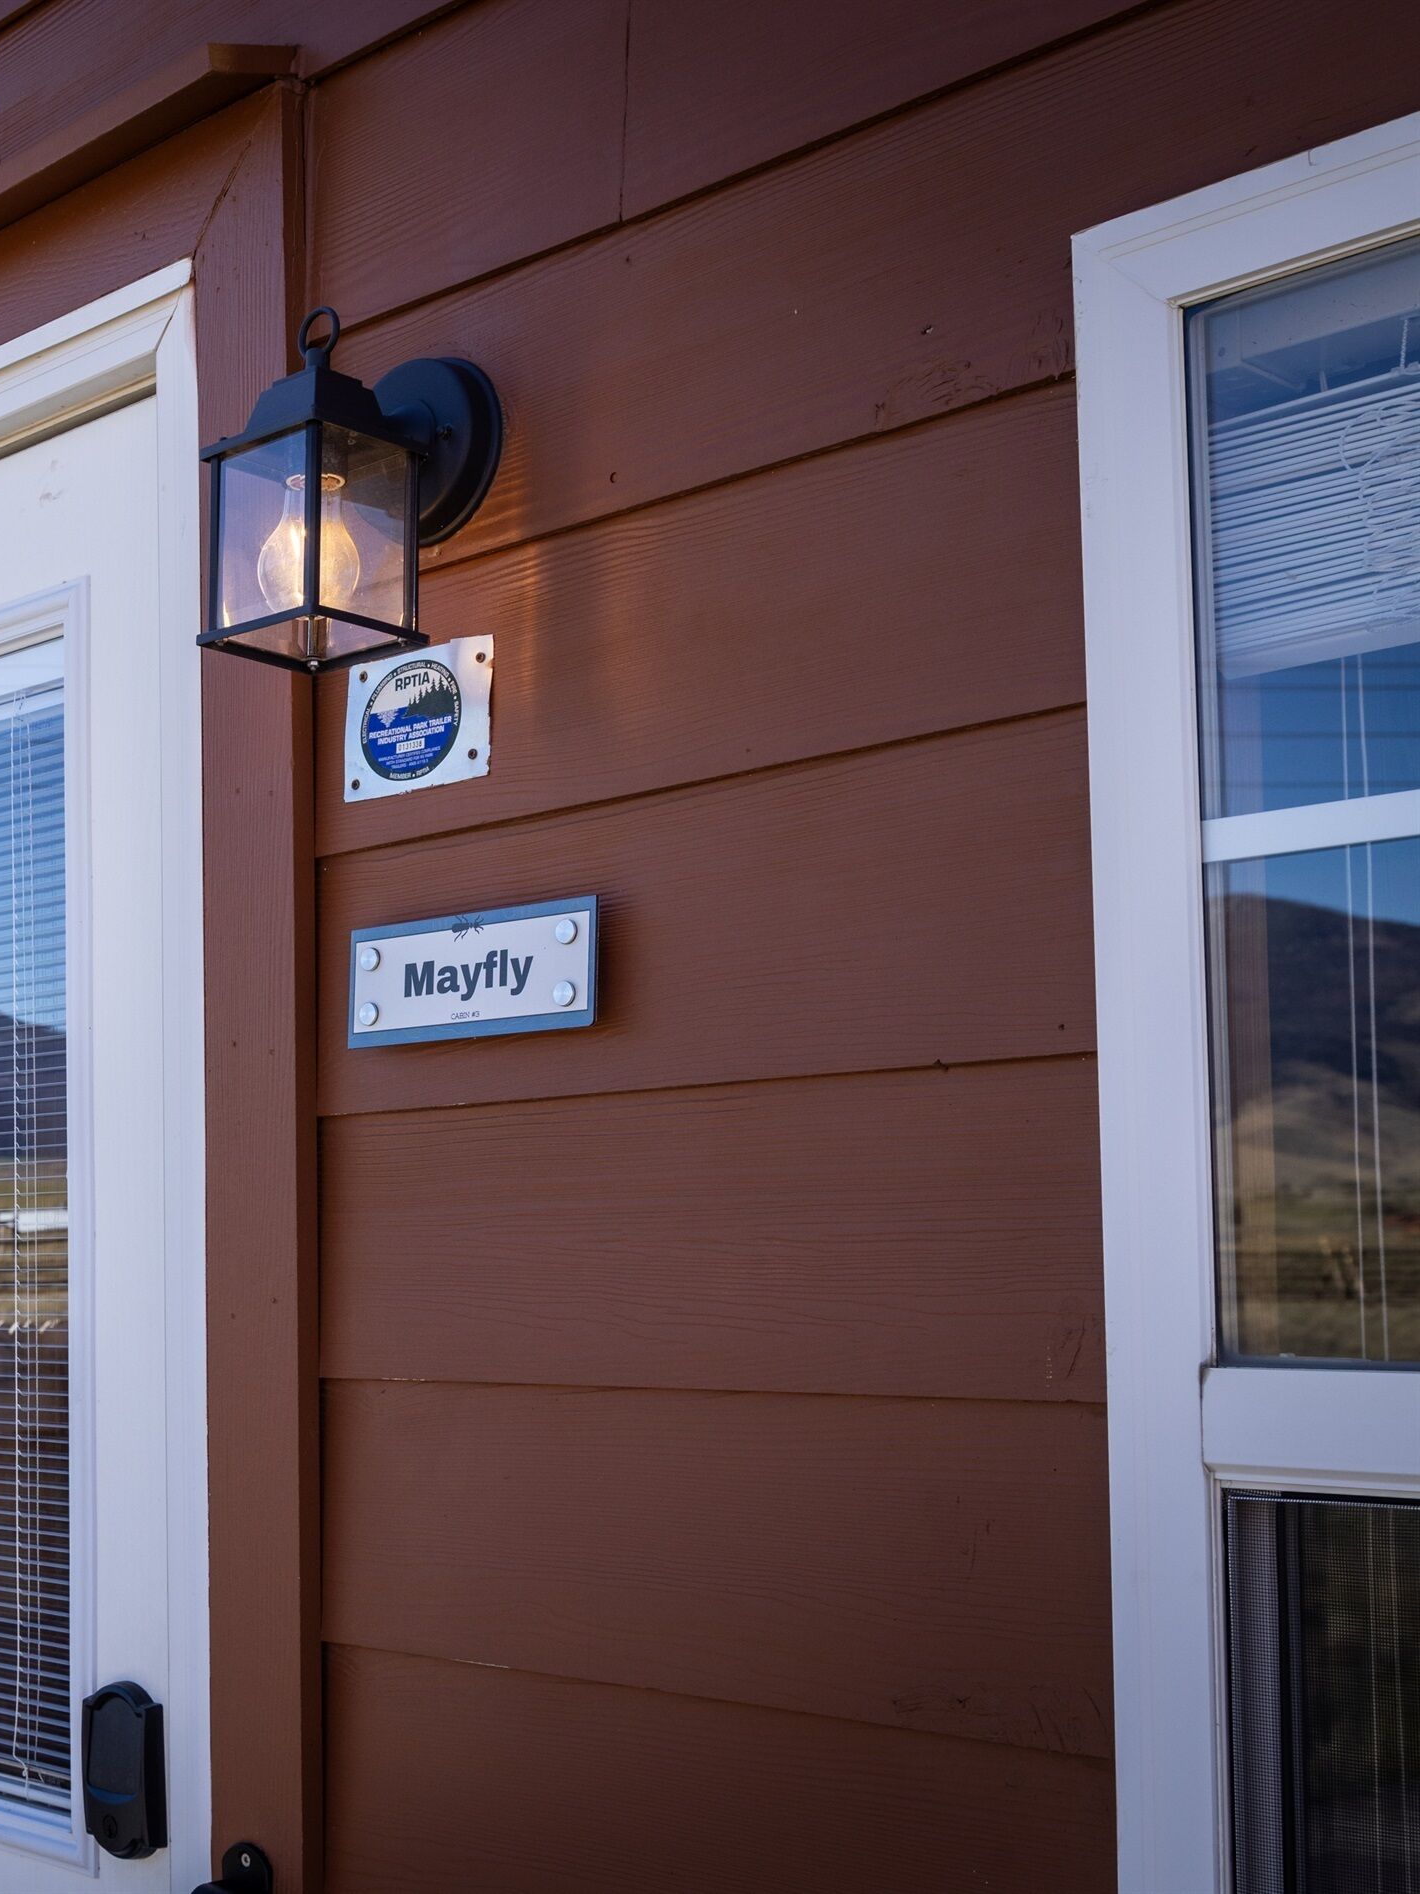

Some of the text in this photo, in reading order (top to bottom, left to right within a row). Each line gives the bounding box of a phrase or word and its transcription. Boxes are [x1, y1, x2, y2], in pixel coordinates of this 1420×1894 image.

[395, 671, 430, 691] RPTIA
[362, 706, 372, 744] ELECTRICAL
[372, 674, 393, 701] PLUMBING
[397, 662, 426, 674] STRUCTURAL
[431, 662, 450, 677] HEATING
[369, 716, 452, 740] RECREATIONAL PARK TRAILER
[377, 725, 445, 745] INDUSTRY ASSOCIATION
[389, 771, 412, 780] MEMBER
[404, 950, 534, 1001] Mayfly
[451, 1011, 470, 1020] CABIN
